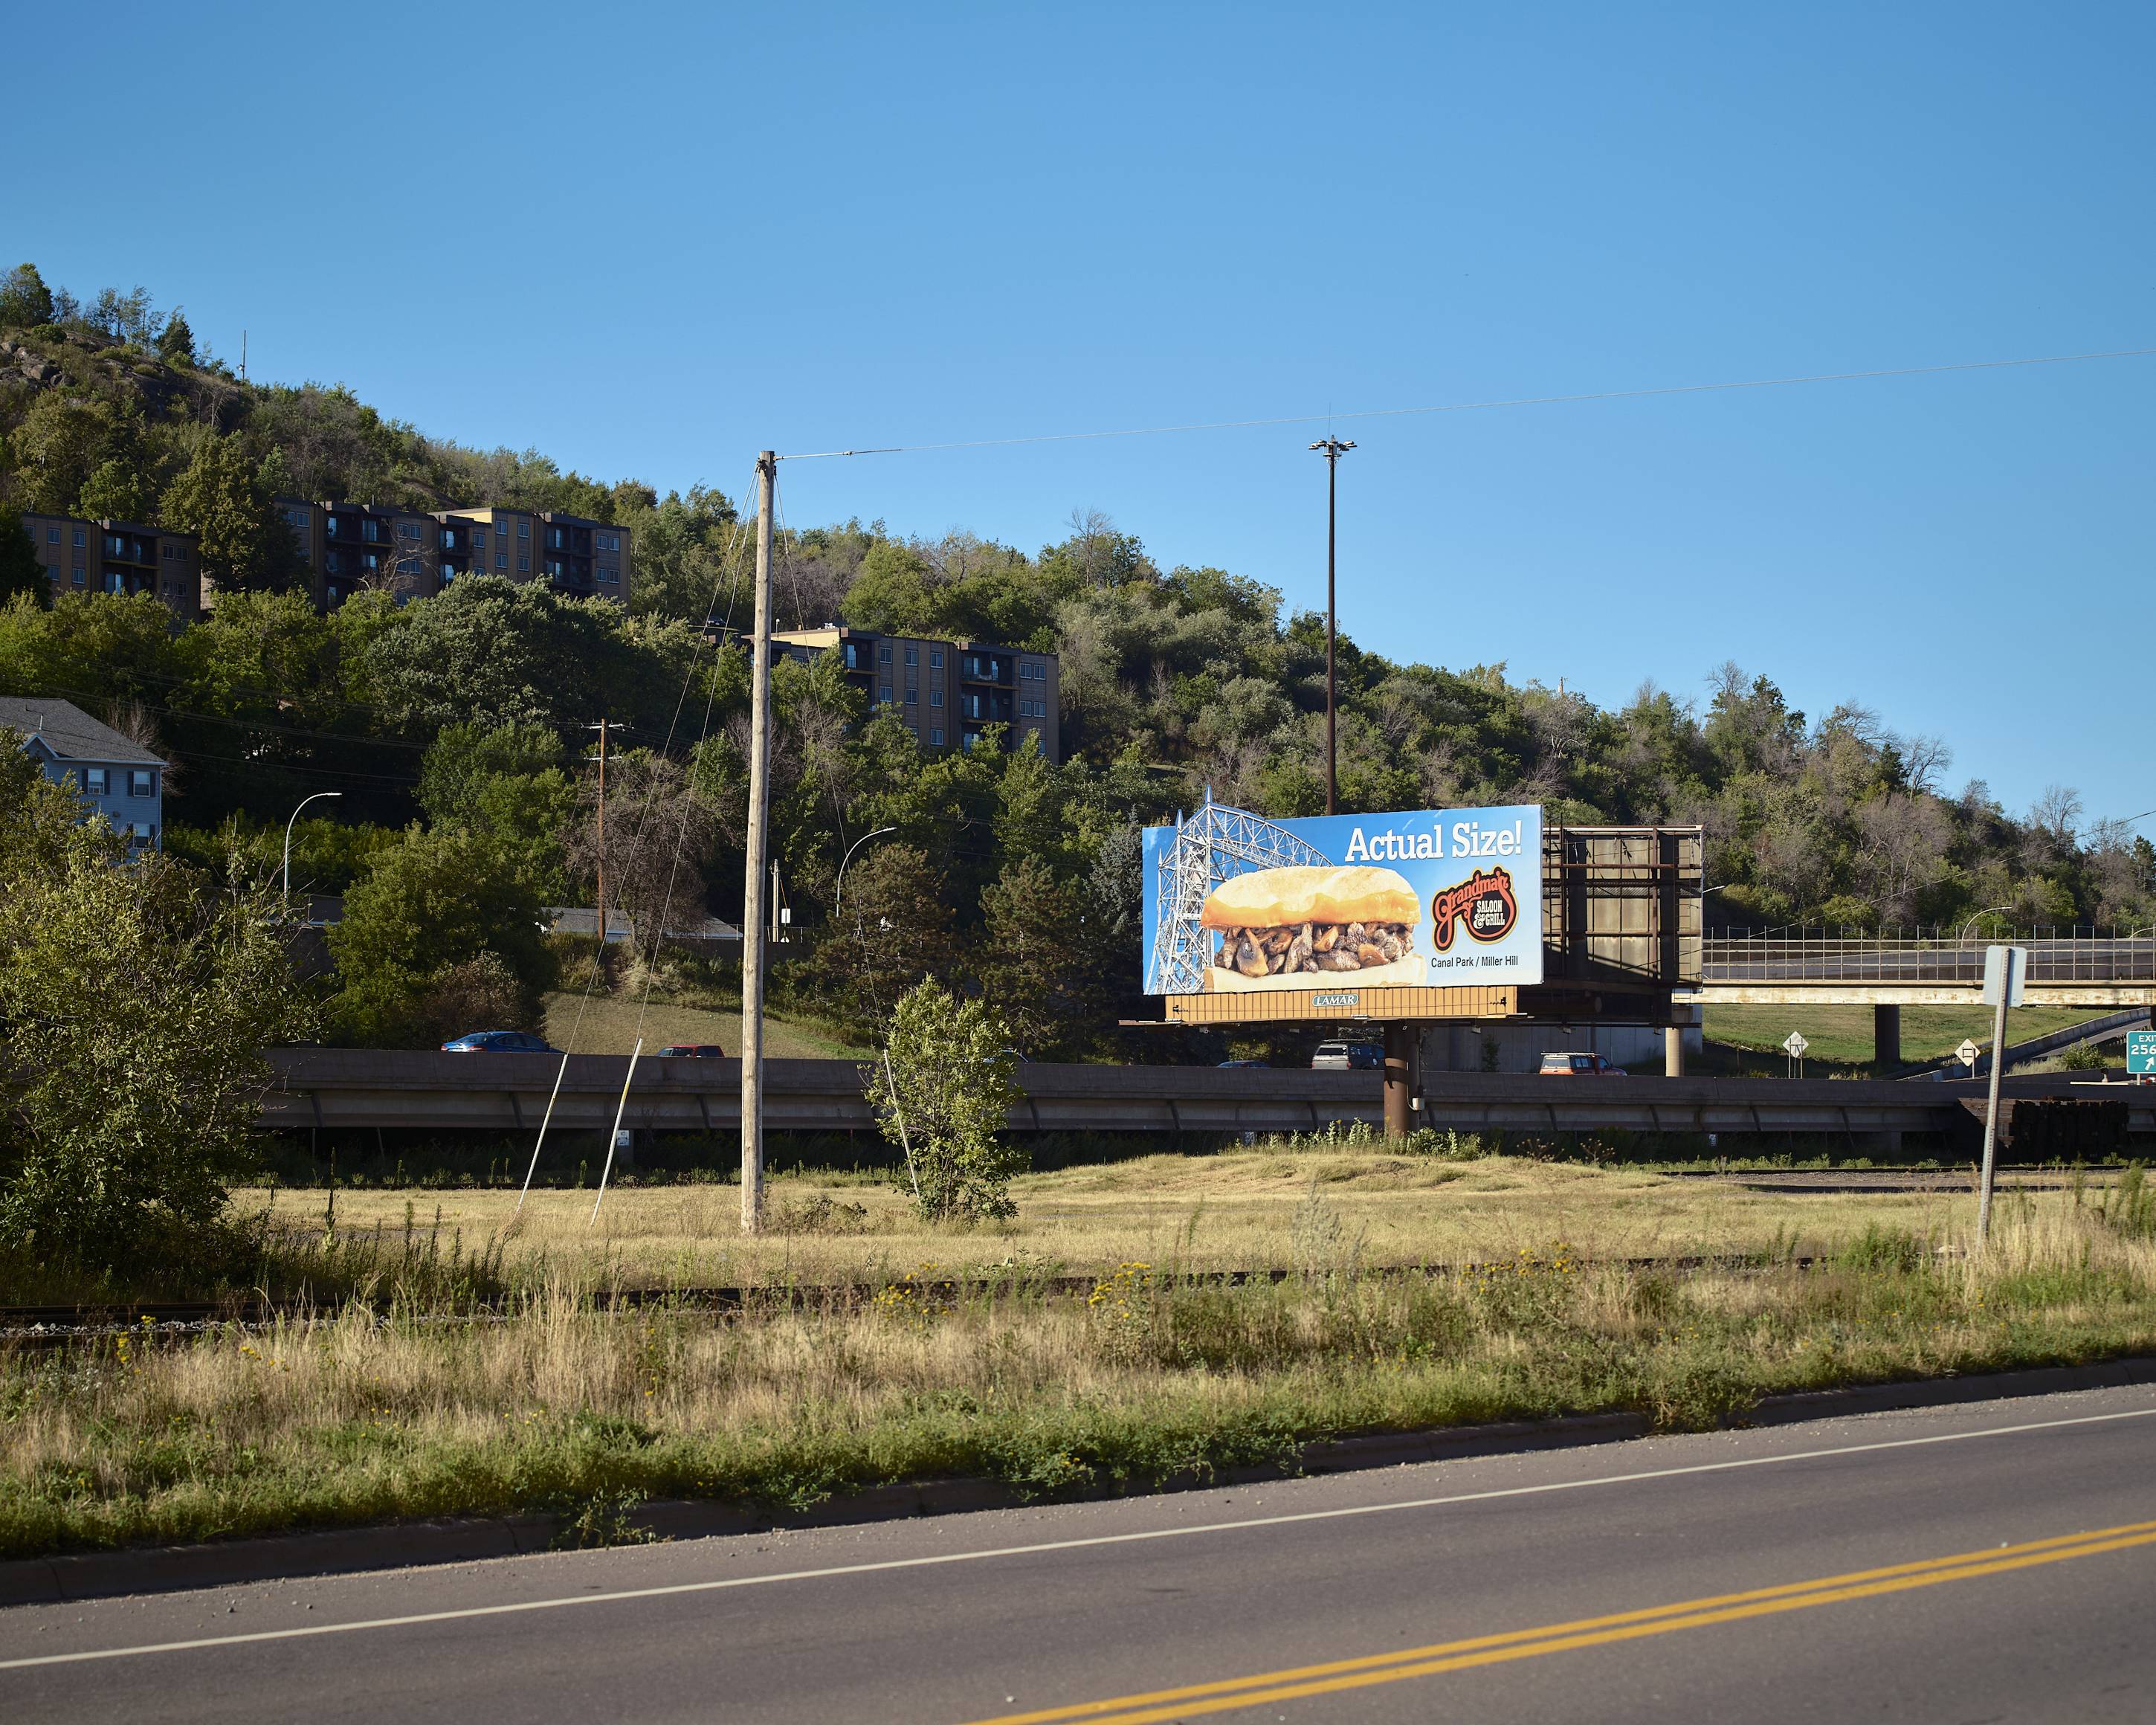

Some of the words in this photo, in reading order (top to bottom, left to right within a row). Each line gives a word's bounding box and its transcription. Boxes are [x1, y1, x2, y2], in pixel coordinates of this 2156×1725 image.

[1344, 824, 1444, 862] Actual
[1452, 820, 1522, 858] Size!
[1476, 900, 1503, 913] SALOON
[1485, 913, 1505, 926] GRILL
[1431, 957, 1453, 967] Canal
[1456, 957, 1474, 967] Park
[1481, 956, 1503, 966] Miller
[1505, 955, 1518, 966] Hill
[1316, 996, 1355, 1005] LAMAR
[2131, 1045, 2156, 1055] 256
